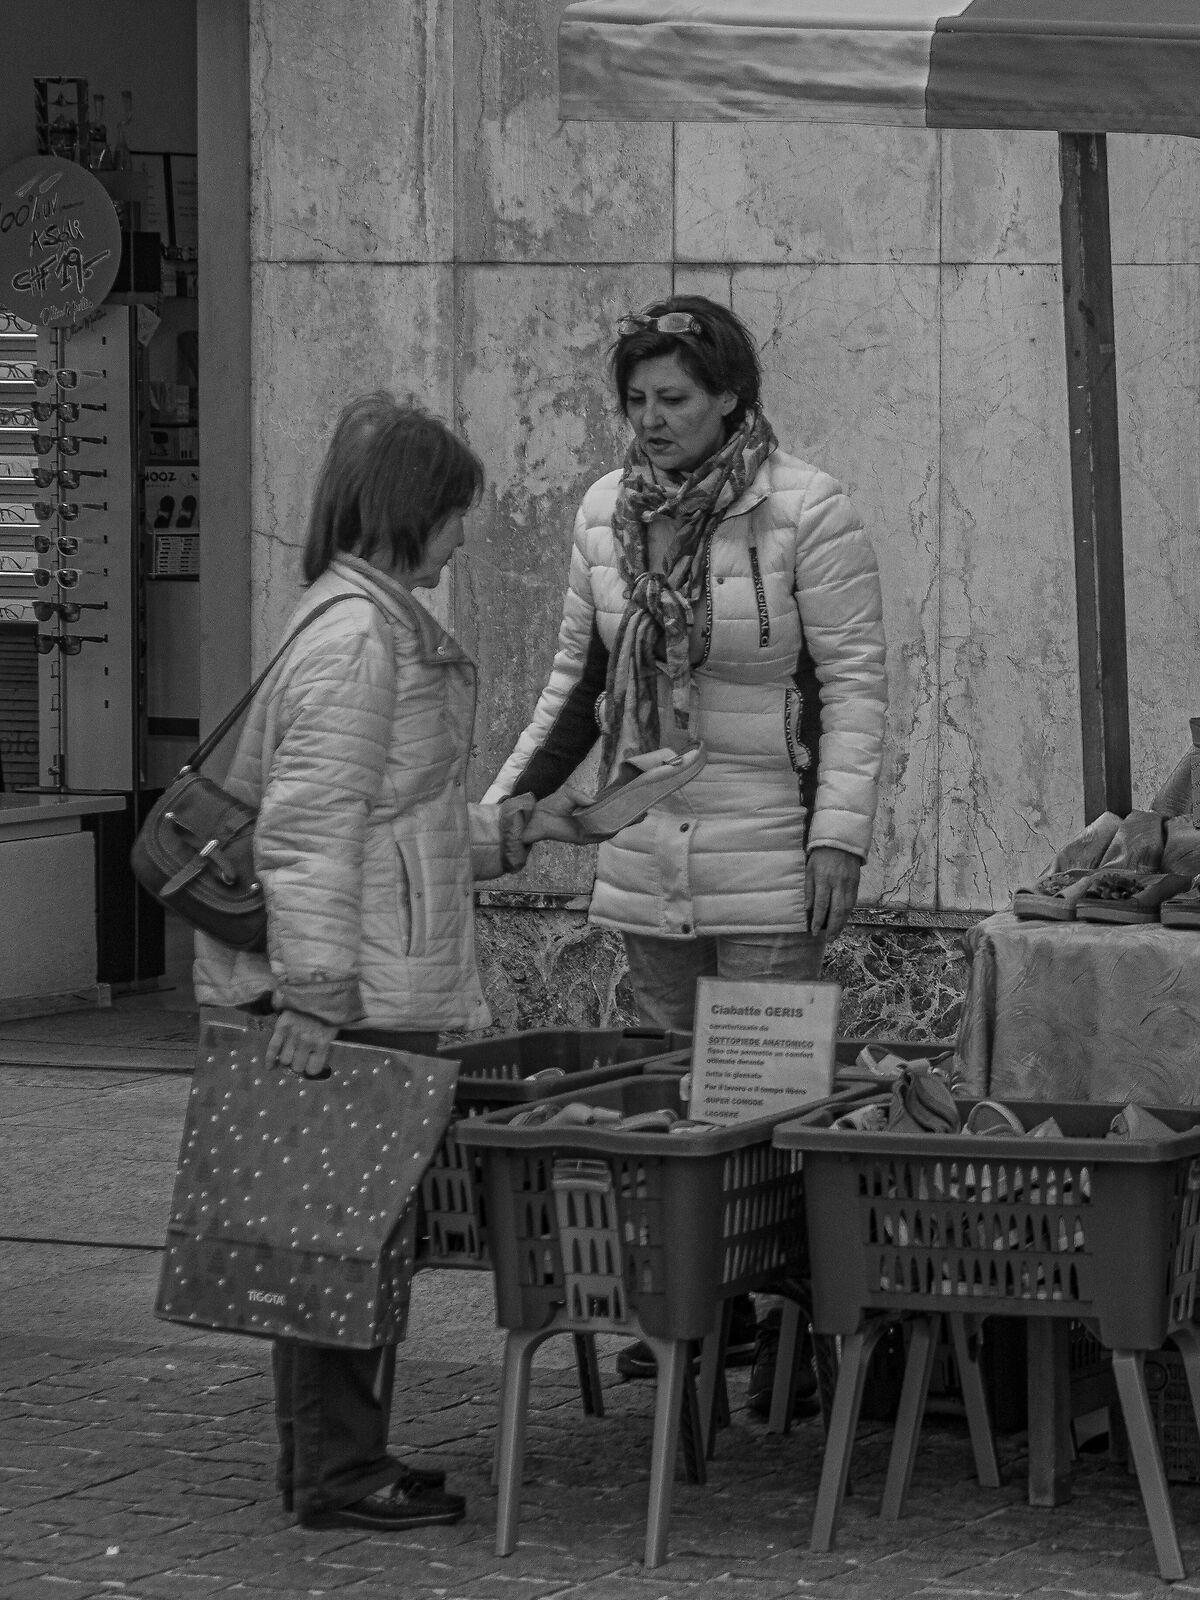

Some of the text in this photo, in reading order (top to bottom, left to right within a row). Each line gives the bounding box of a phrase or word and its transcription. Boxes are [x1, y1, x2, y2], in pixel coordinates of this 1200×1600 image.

[0, 195, 41, 232] 00%
[711, 1004, 804, 1018] Ciabatte GERIS
[762, 1038, 815, 1049] ANATOMICO
